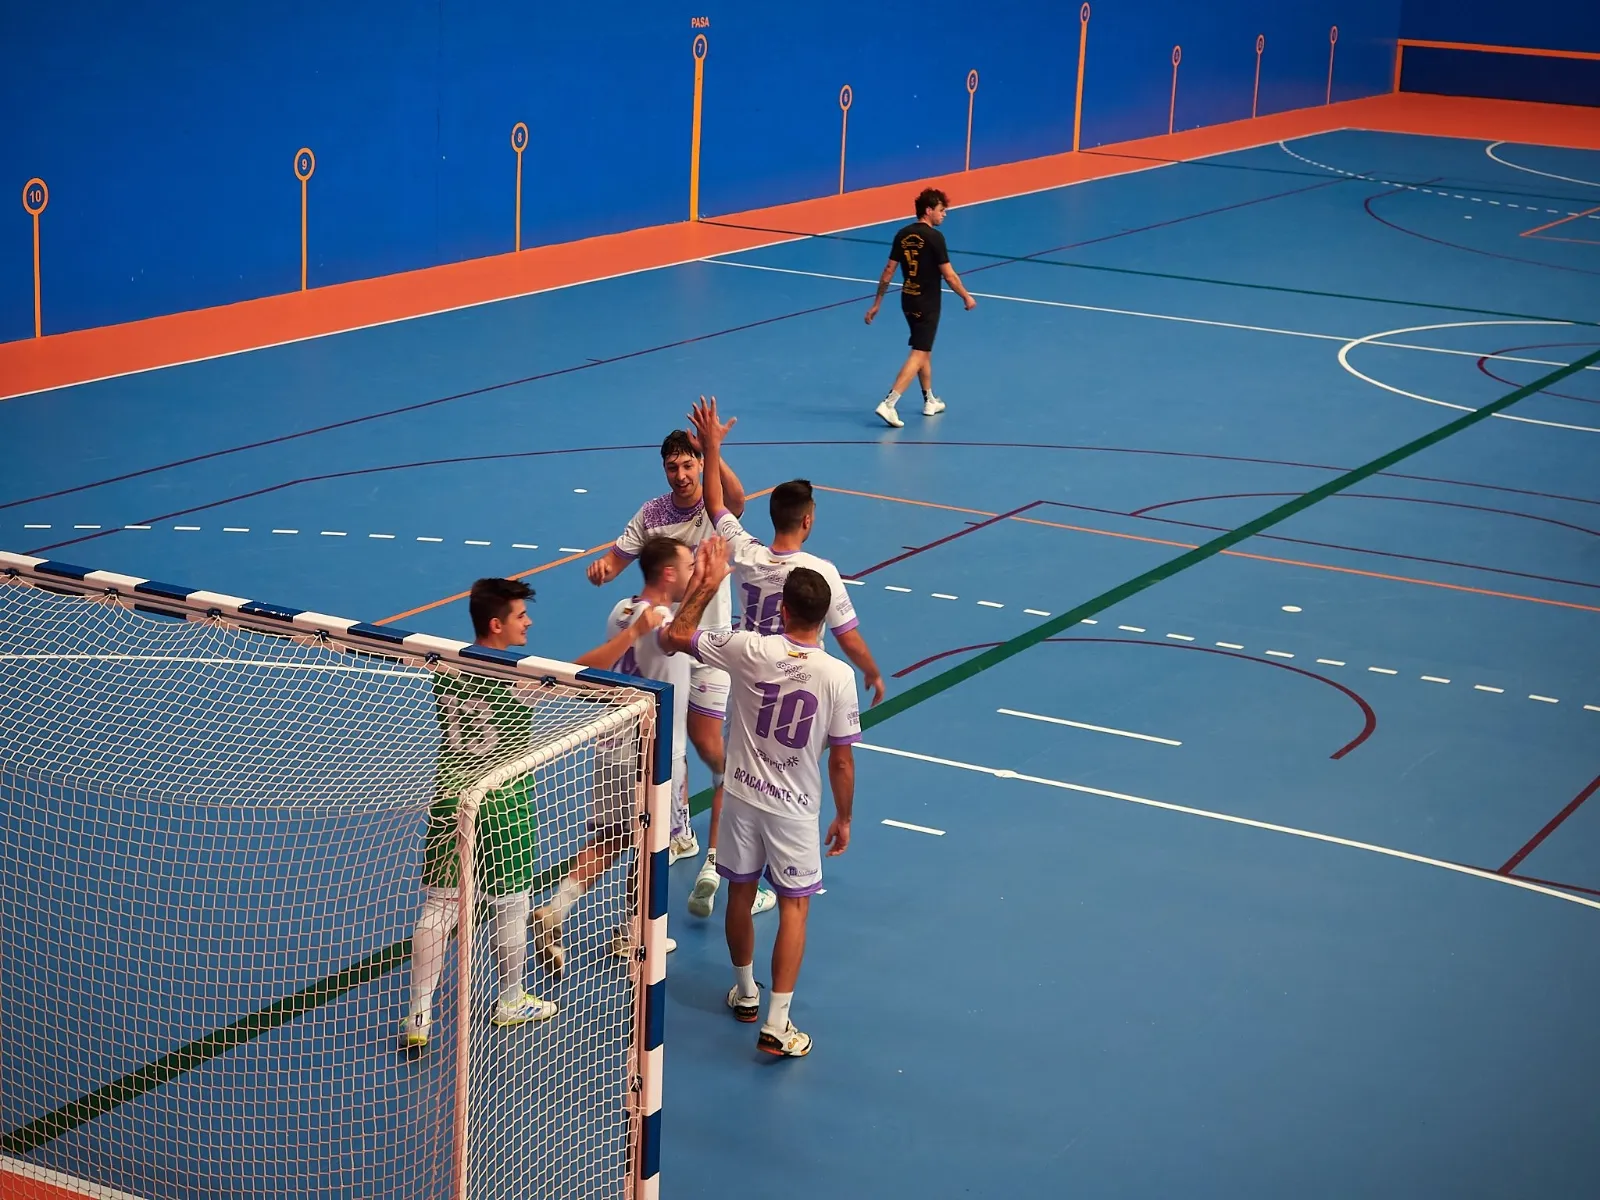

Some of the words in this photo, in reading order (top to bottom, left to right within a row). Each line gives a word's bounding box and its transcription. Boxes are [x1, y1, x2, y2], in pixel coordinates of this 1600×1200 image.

[691, 16, 710, 29] PASA
[517, 132, 523, 143] 8
[301, 158, 308, 170] 9
[29, 189, 42, 203] 10
[755, 681, 819, 750] 10
[733, 767, 792, 803] BRACAMONTE
